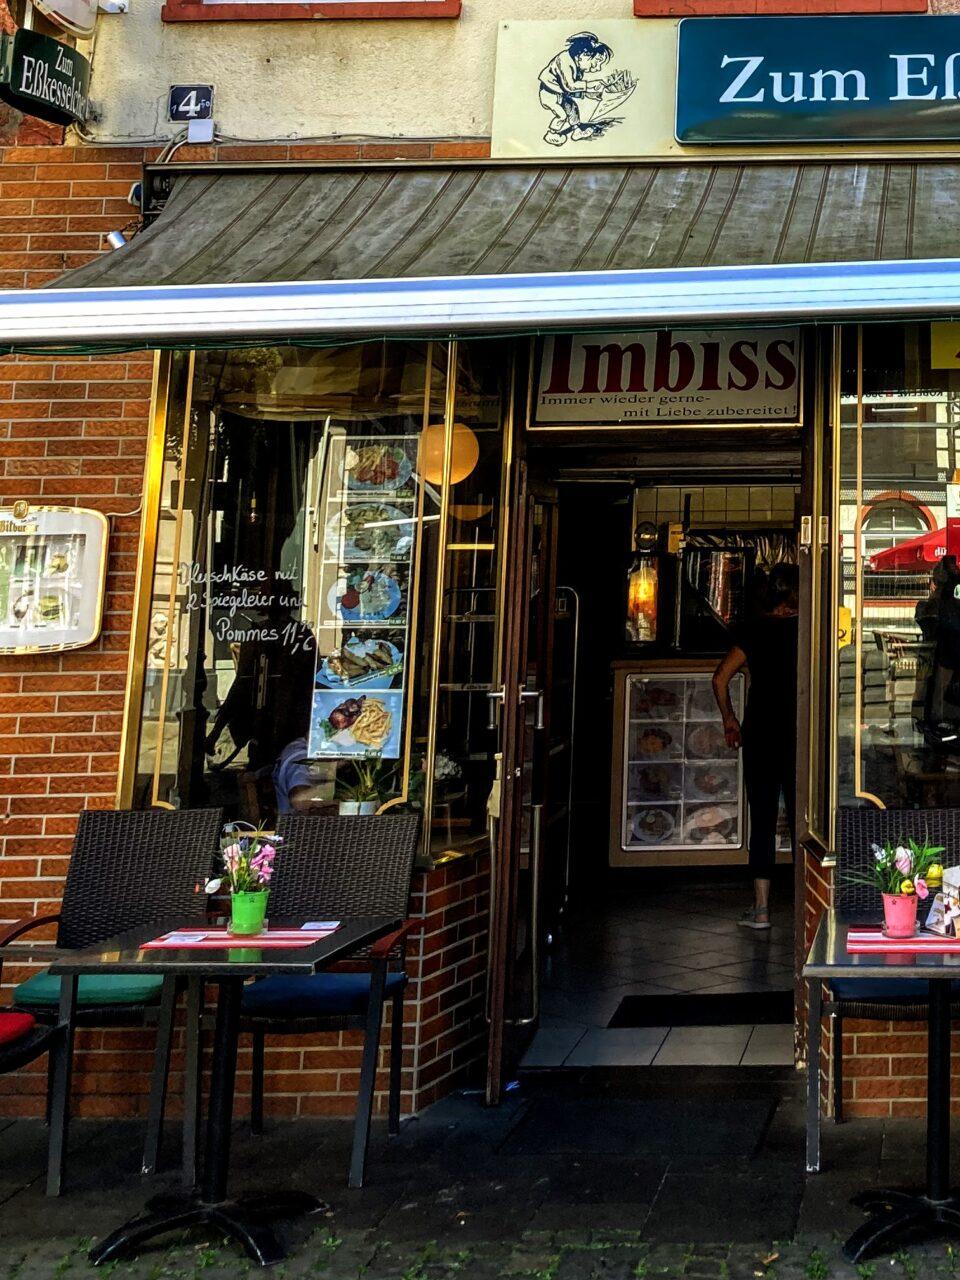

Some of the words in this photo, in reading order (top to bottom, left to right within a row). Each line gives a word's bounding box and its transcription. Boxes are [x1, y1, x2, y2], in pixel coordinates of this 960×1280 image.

[55, 46, 74, 78] Zum
[719, 53, 870, 104] Zum
[178, 90, 201, 117] 4
[542, 330, 797, 395] Imbiss
[540, 396, 595, 405] Immer
[600, 394, 654, 404] wieder
[623, 407, 650, 417] mit
[655, 406, 702, 417] Liebe
[216, 617, 280, 642] Pommes
